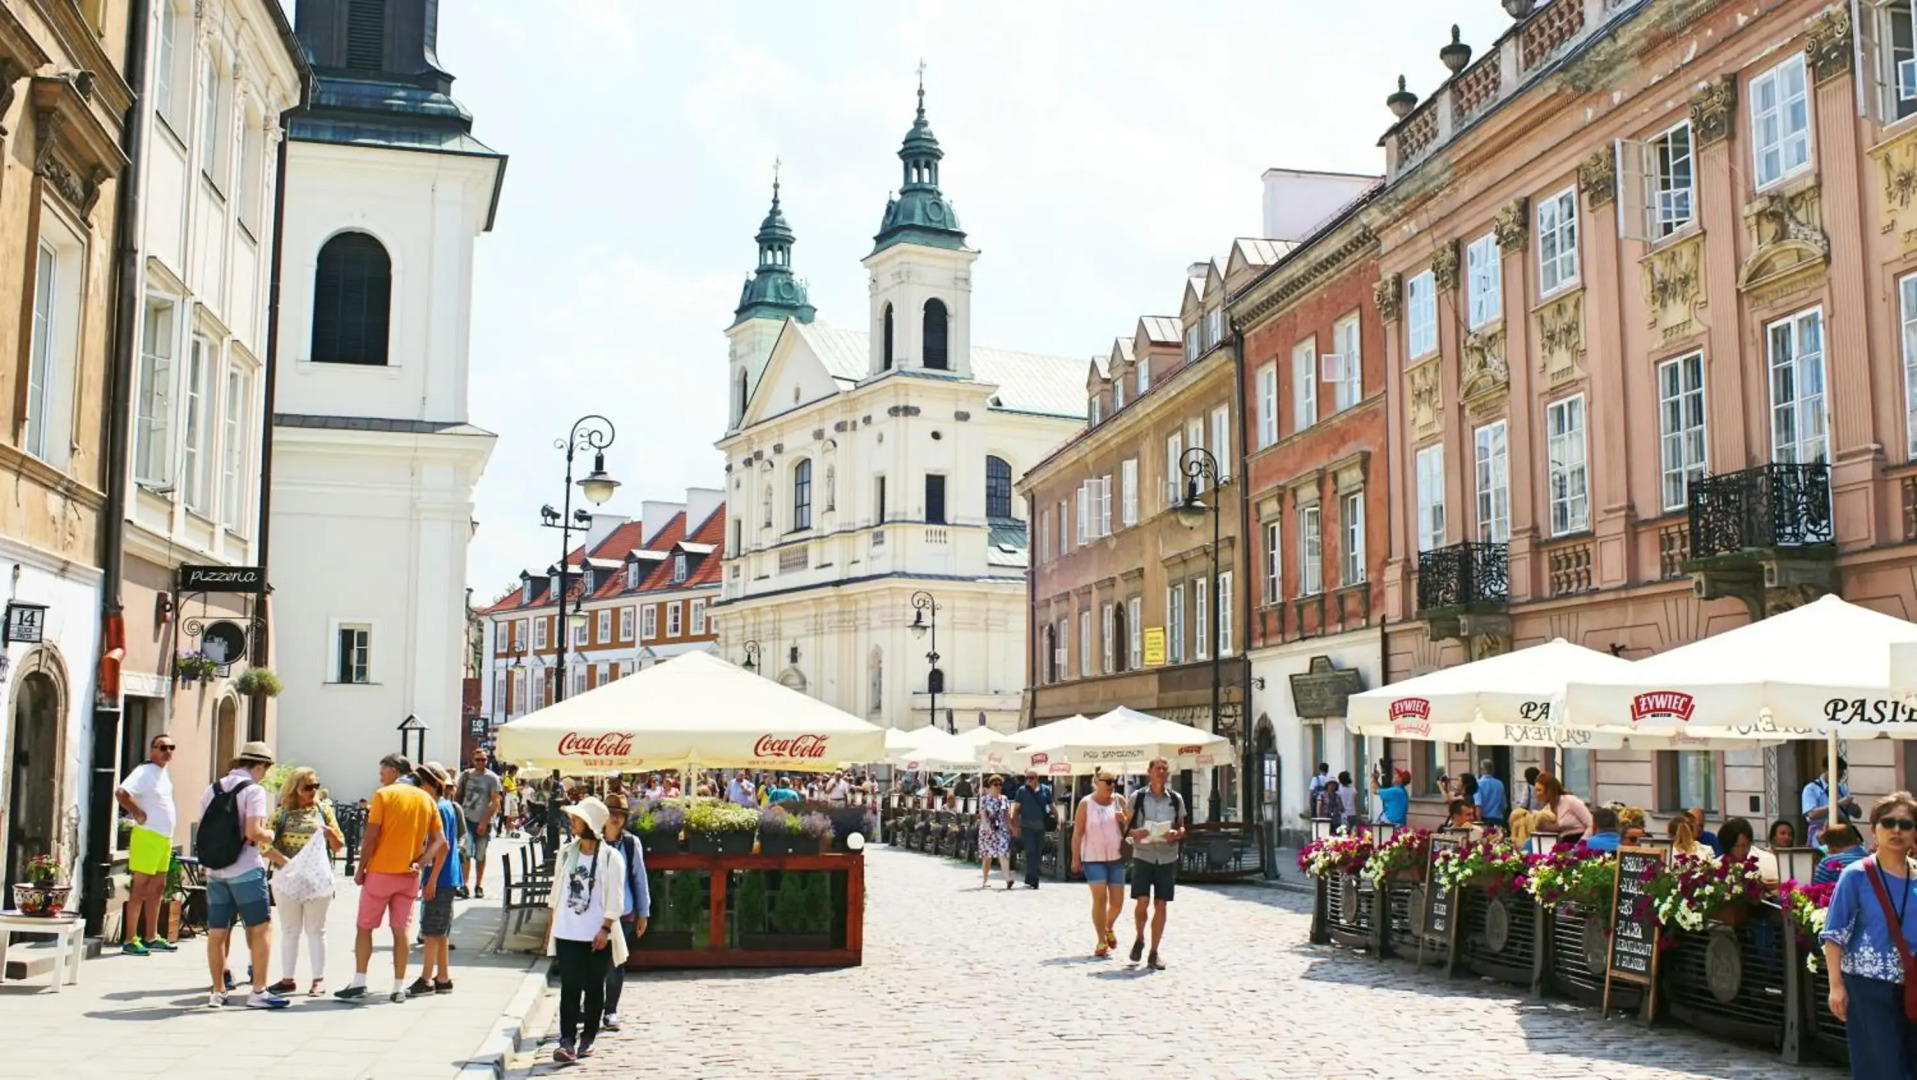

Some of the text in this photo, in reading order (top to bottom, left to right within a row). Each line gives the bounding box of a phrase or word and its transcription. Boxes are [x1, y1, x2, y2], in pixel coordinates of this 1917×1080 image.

[189, 570, 258, 586] pizzeria
[18, 610, 36, 627] 14
[1639, 693, 1688, 713] ŻYWIEC
